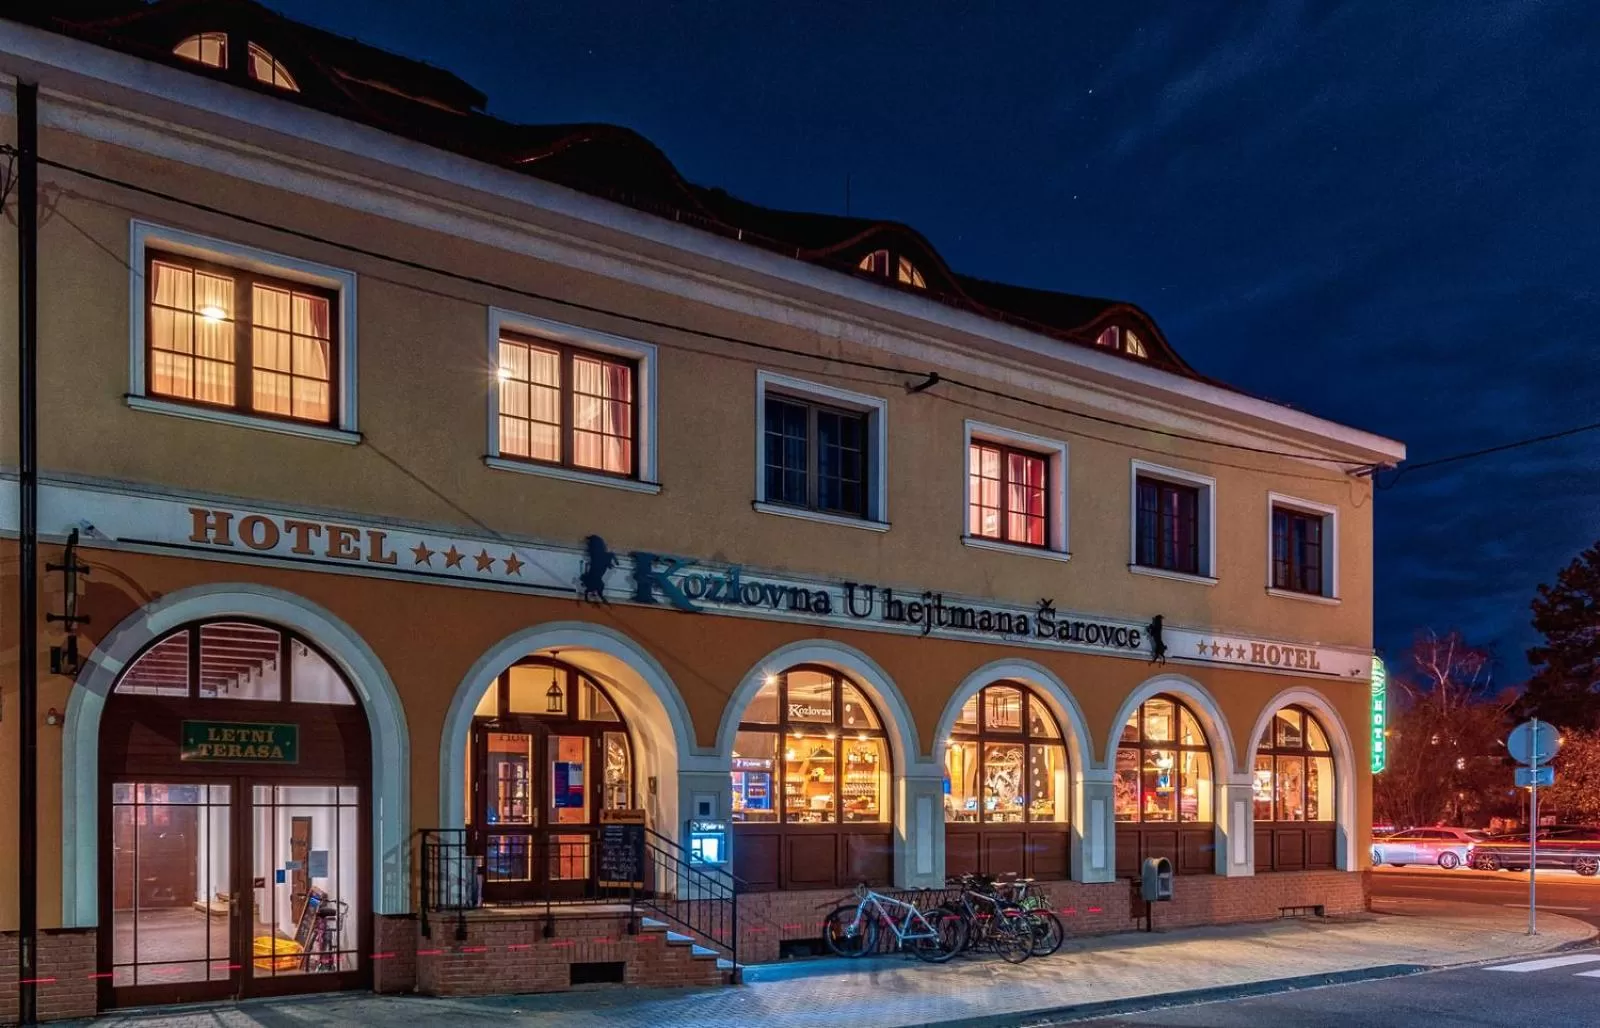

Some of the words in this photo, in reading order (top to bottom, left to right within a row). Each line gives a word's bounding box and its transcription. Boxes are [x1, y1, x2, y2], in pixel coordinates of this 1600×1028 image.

[188, 507, 398, 565] HOTEL
[631, 552, 832, 614] Kozlovna
[844, 581, 876, 618] U
[881, 587, 1030, 636] hejtmana
[1036, 598, 1141, 649] Šarovce
[1251, 642, 1321, 670] HOTEL
[197, 743, 284, 759] TERASA
[1374, 699, 1384, 767] HOTEL
